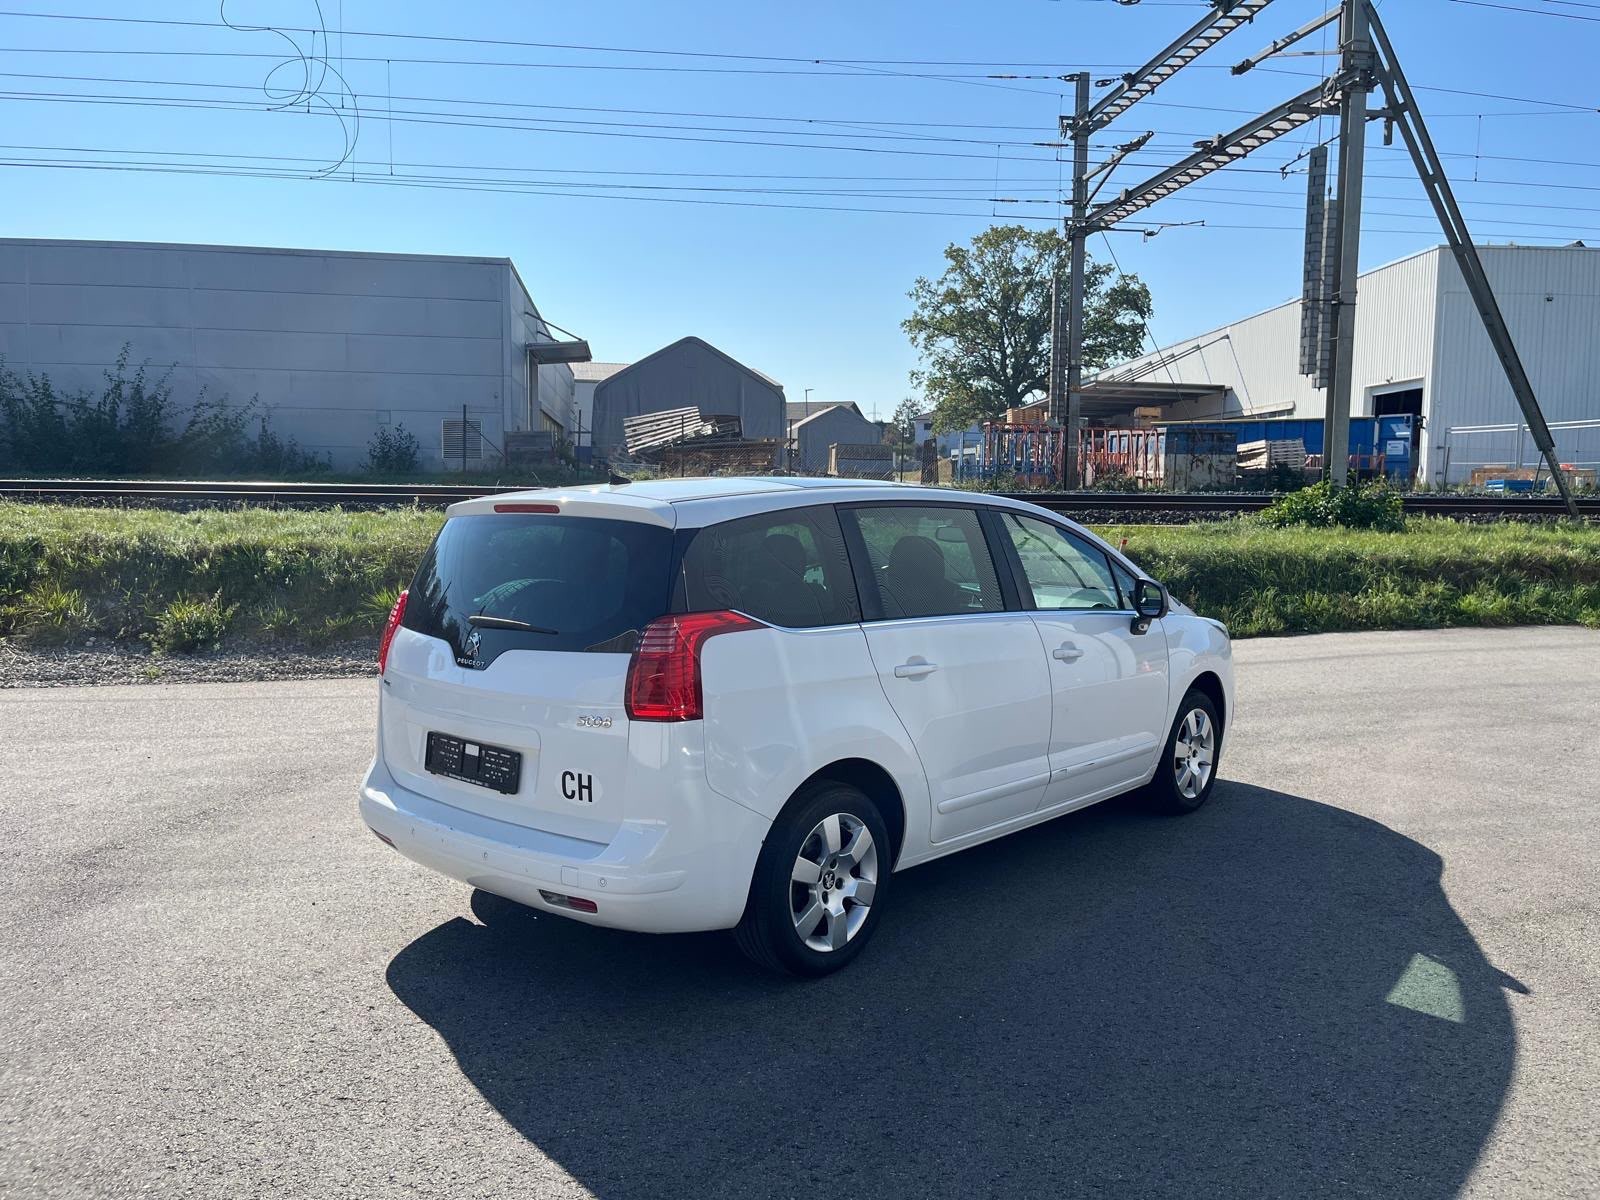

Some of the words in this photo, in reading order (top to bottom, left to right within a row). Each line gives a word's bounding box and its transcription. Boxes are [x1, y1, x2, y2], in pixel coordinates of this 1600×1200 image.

[457, 657, 485, 667] PEUGEOT
[577, 714, 613, 729] 5008
[561, 770, 593, 803] CH
